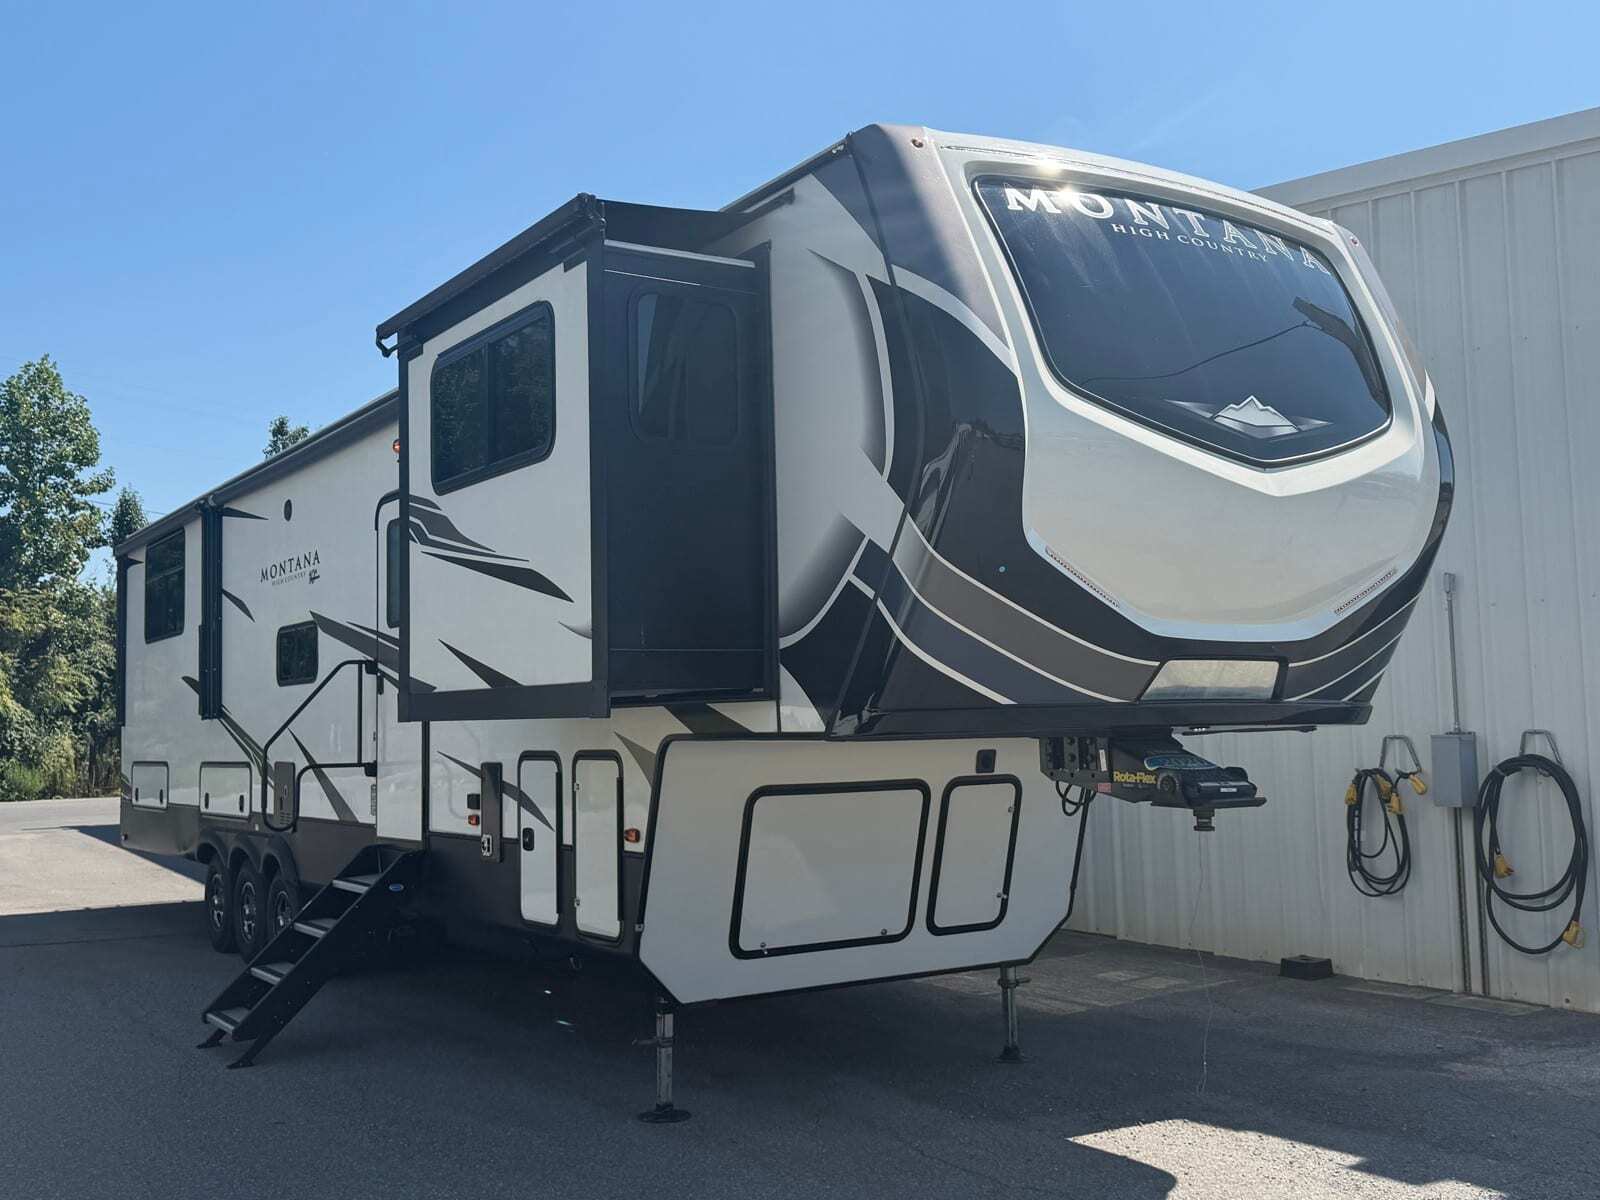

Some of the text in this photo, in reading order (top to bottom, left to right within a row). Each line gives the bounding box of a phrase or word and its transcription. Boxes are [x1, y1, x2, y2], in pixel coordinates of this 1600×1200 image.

[1003, 182, 1331, 275] MONTANA
[1111, 223, 1268, 262] HIGH COUNTRY
[260, 550, 320, 583] MONTANA
